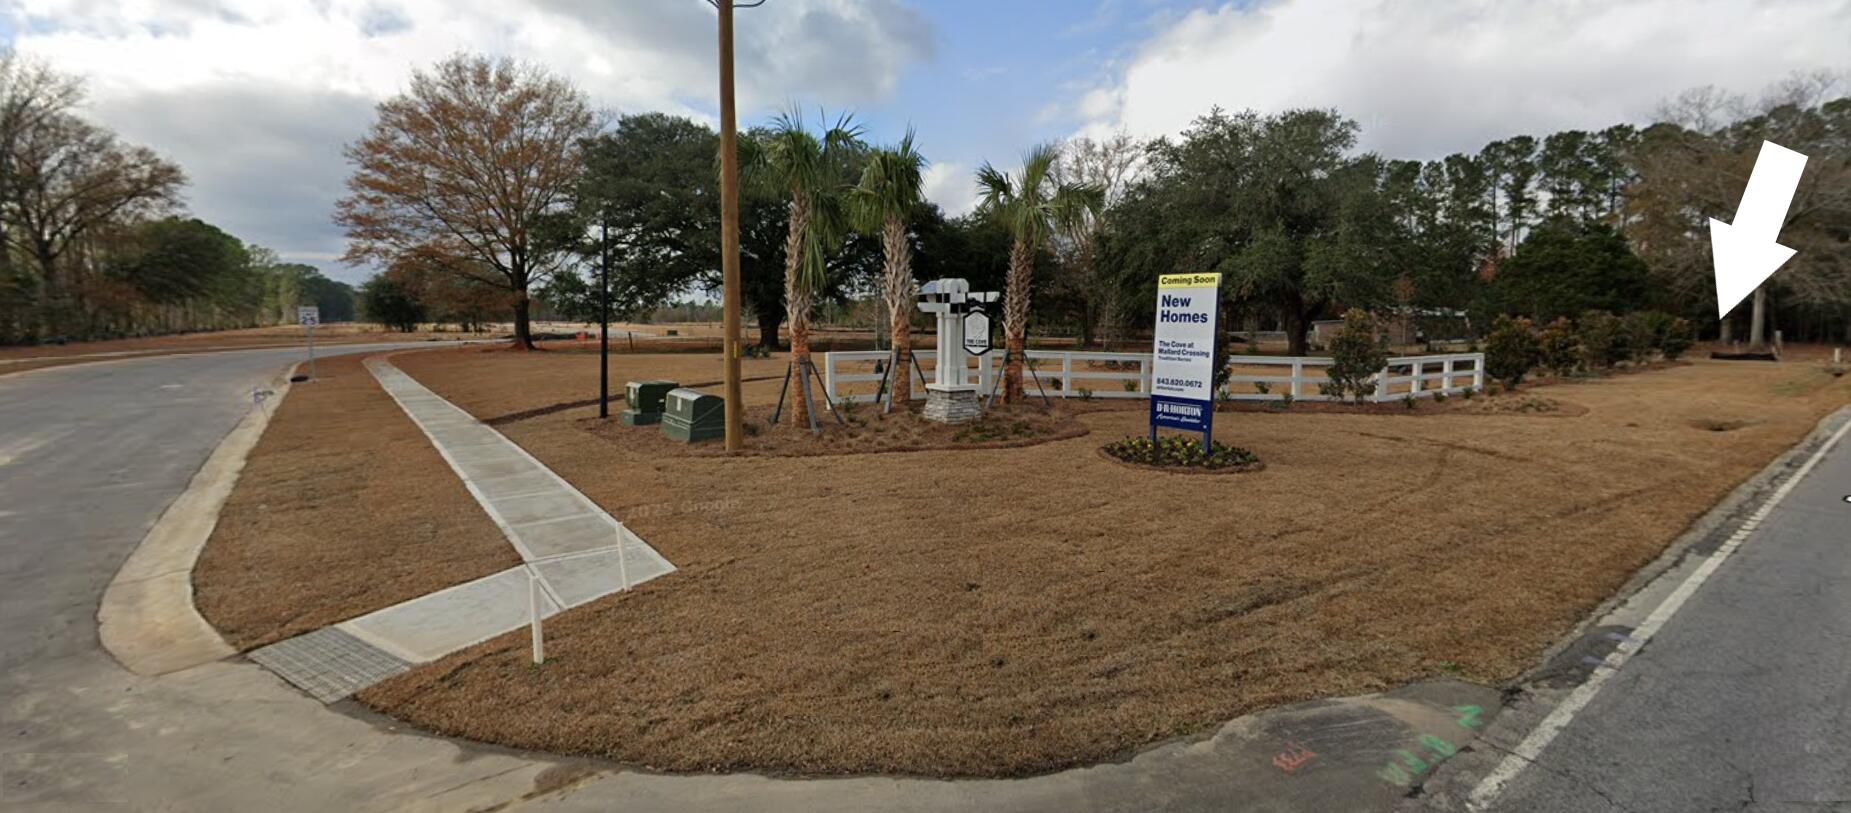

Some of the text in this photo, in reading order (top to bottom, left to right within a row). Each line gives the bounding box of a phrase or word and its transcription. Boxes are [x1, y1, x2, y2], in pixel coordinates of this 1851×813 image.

[1161, 275, 1216, 285] Coming Soon
[1161, 294, 1191, 307] New
[1160, 310, 1208, 323] Homes
[1181, 349, 1210, 358] Crossing
